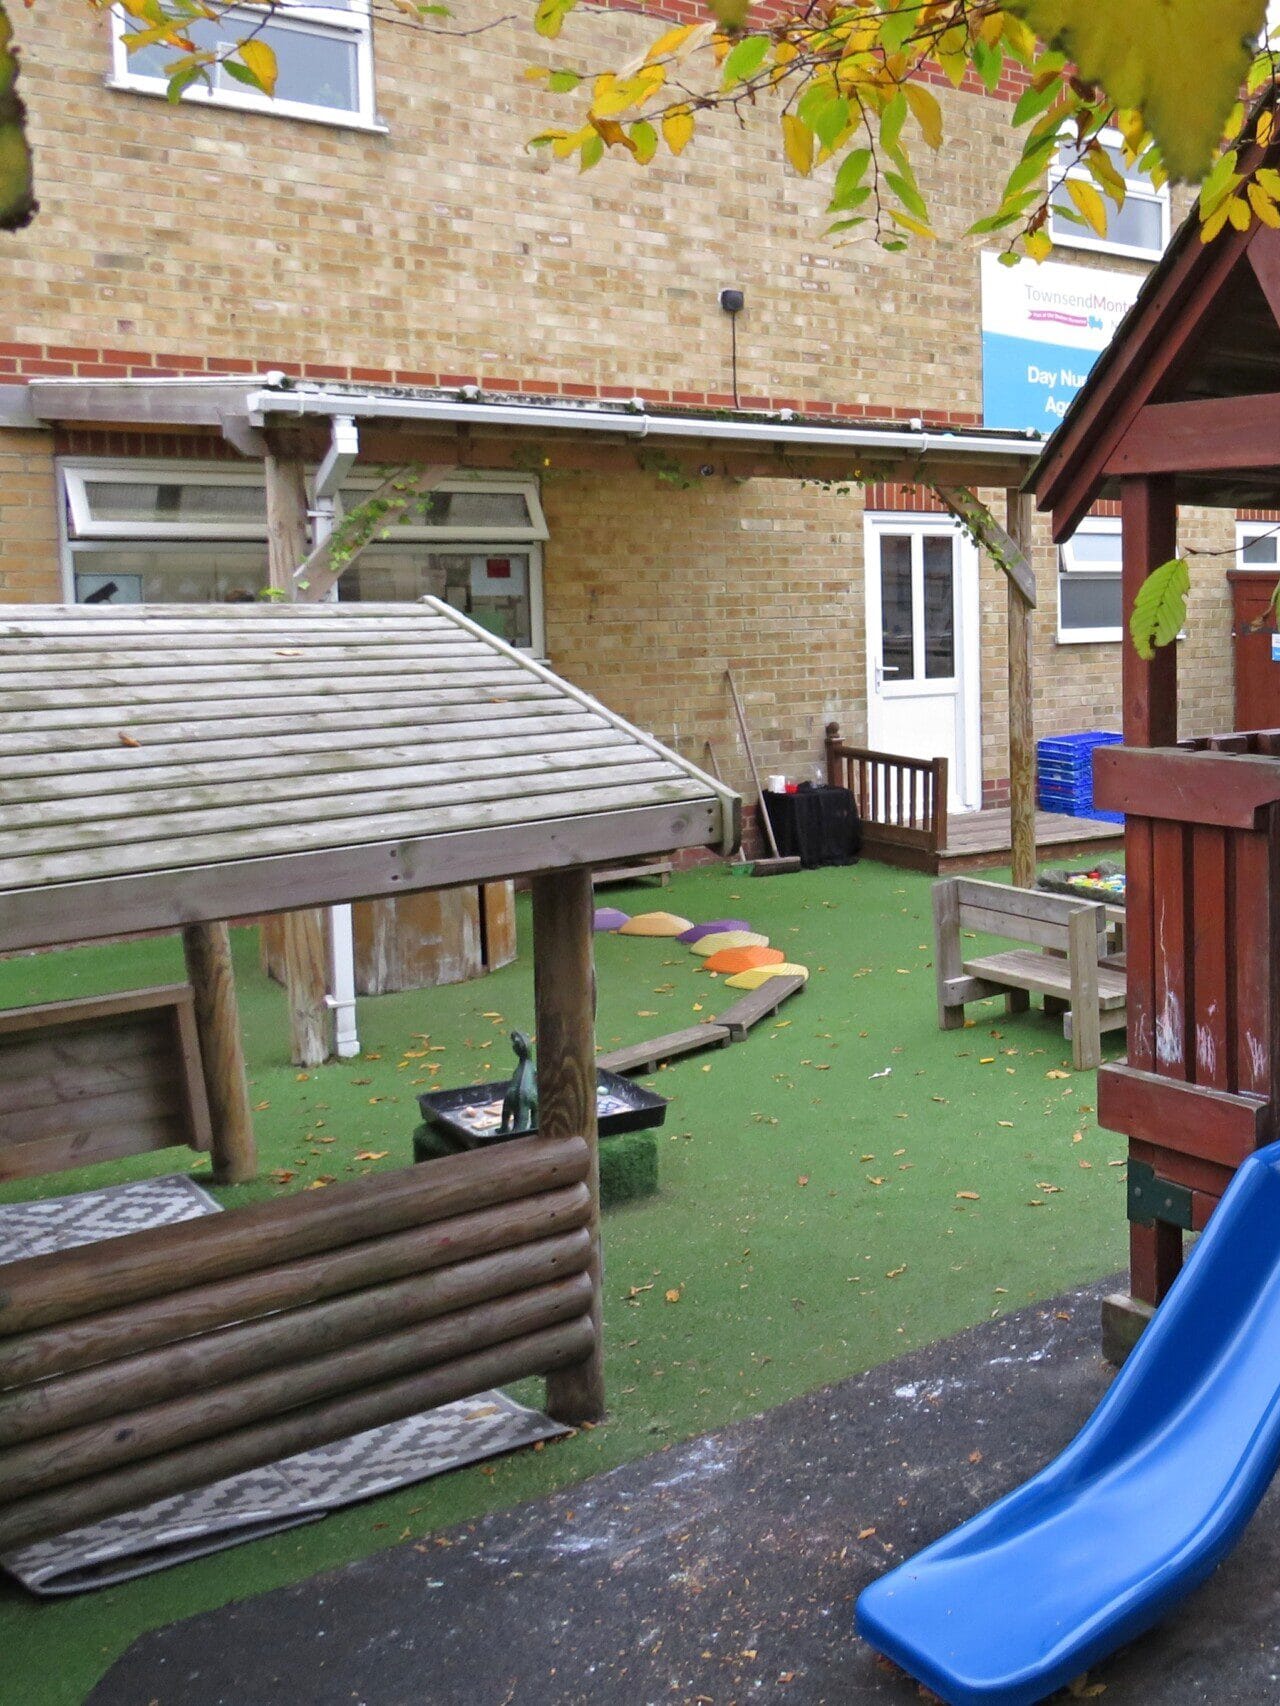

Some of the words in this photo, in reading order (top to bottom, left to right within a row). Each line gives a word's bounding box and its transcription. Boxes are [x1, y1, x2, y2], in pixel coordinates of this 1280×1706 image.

[1024, 284, 1135, 312] TownsendMont
[1028, 366, 1057, 388] Day
[1045, 396, 1070, 417] Ag
